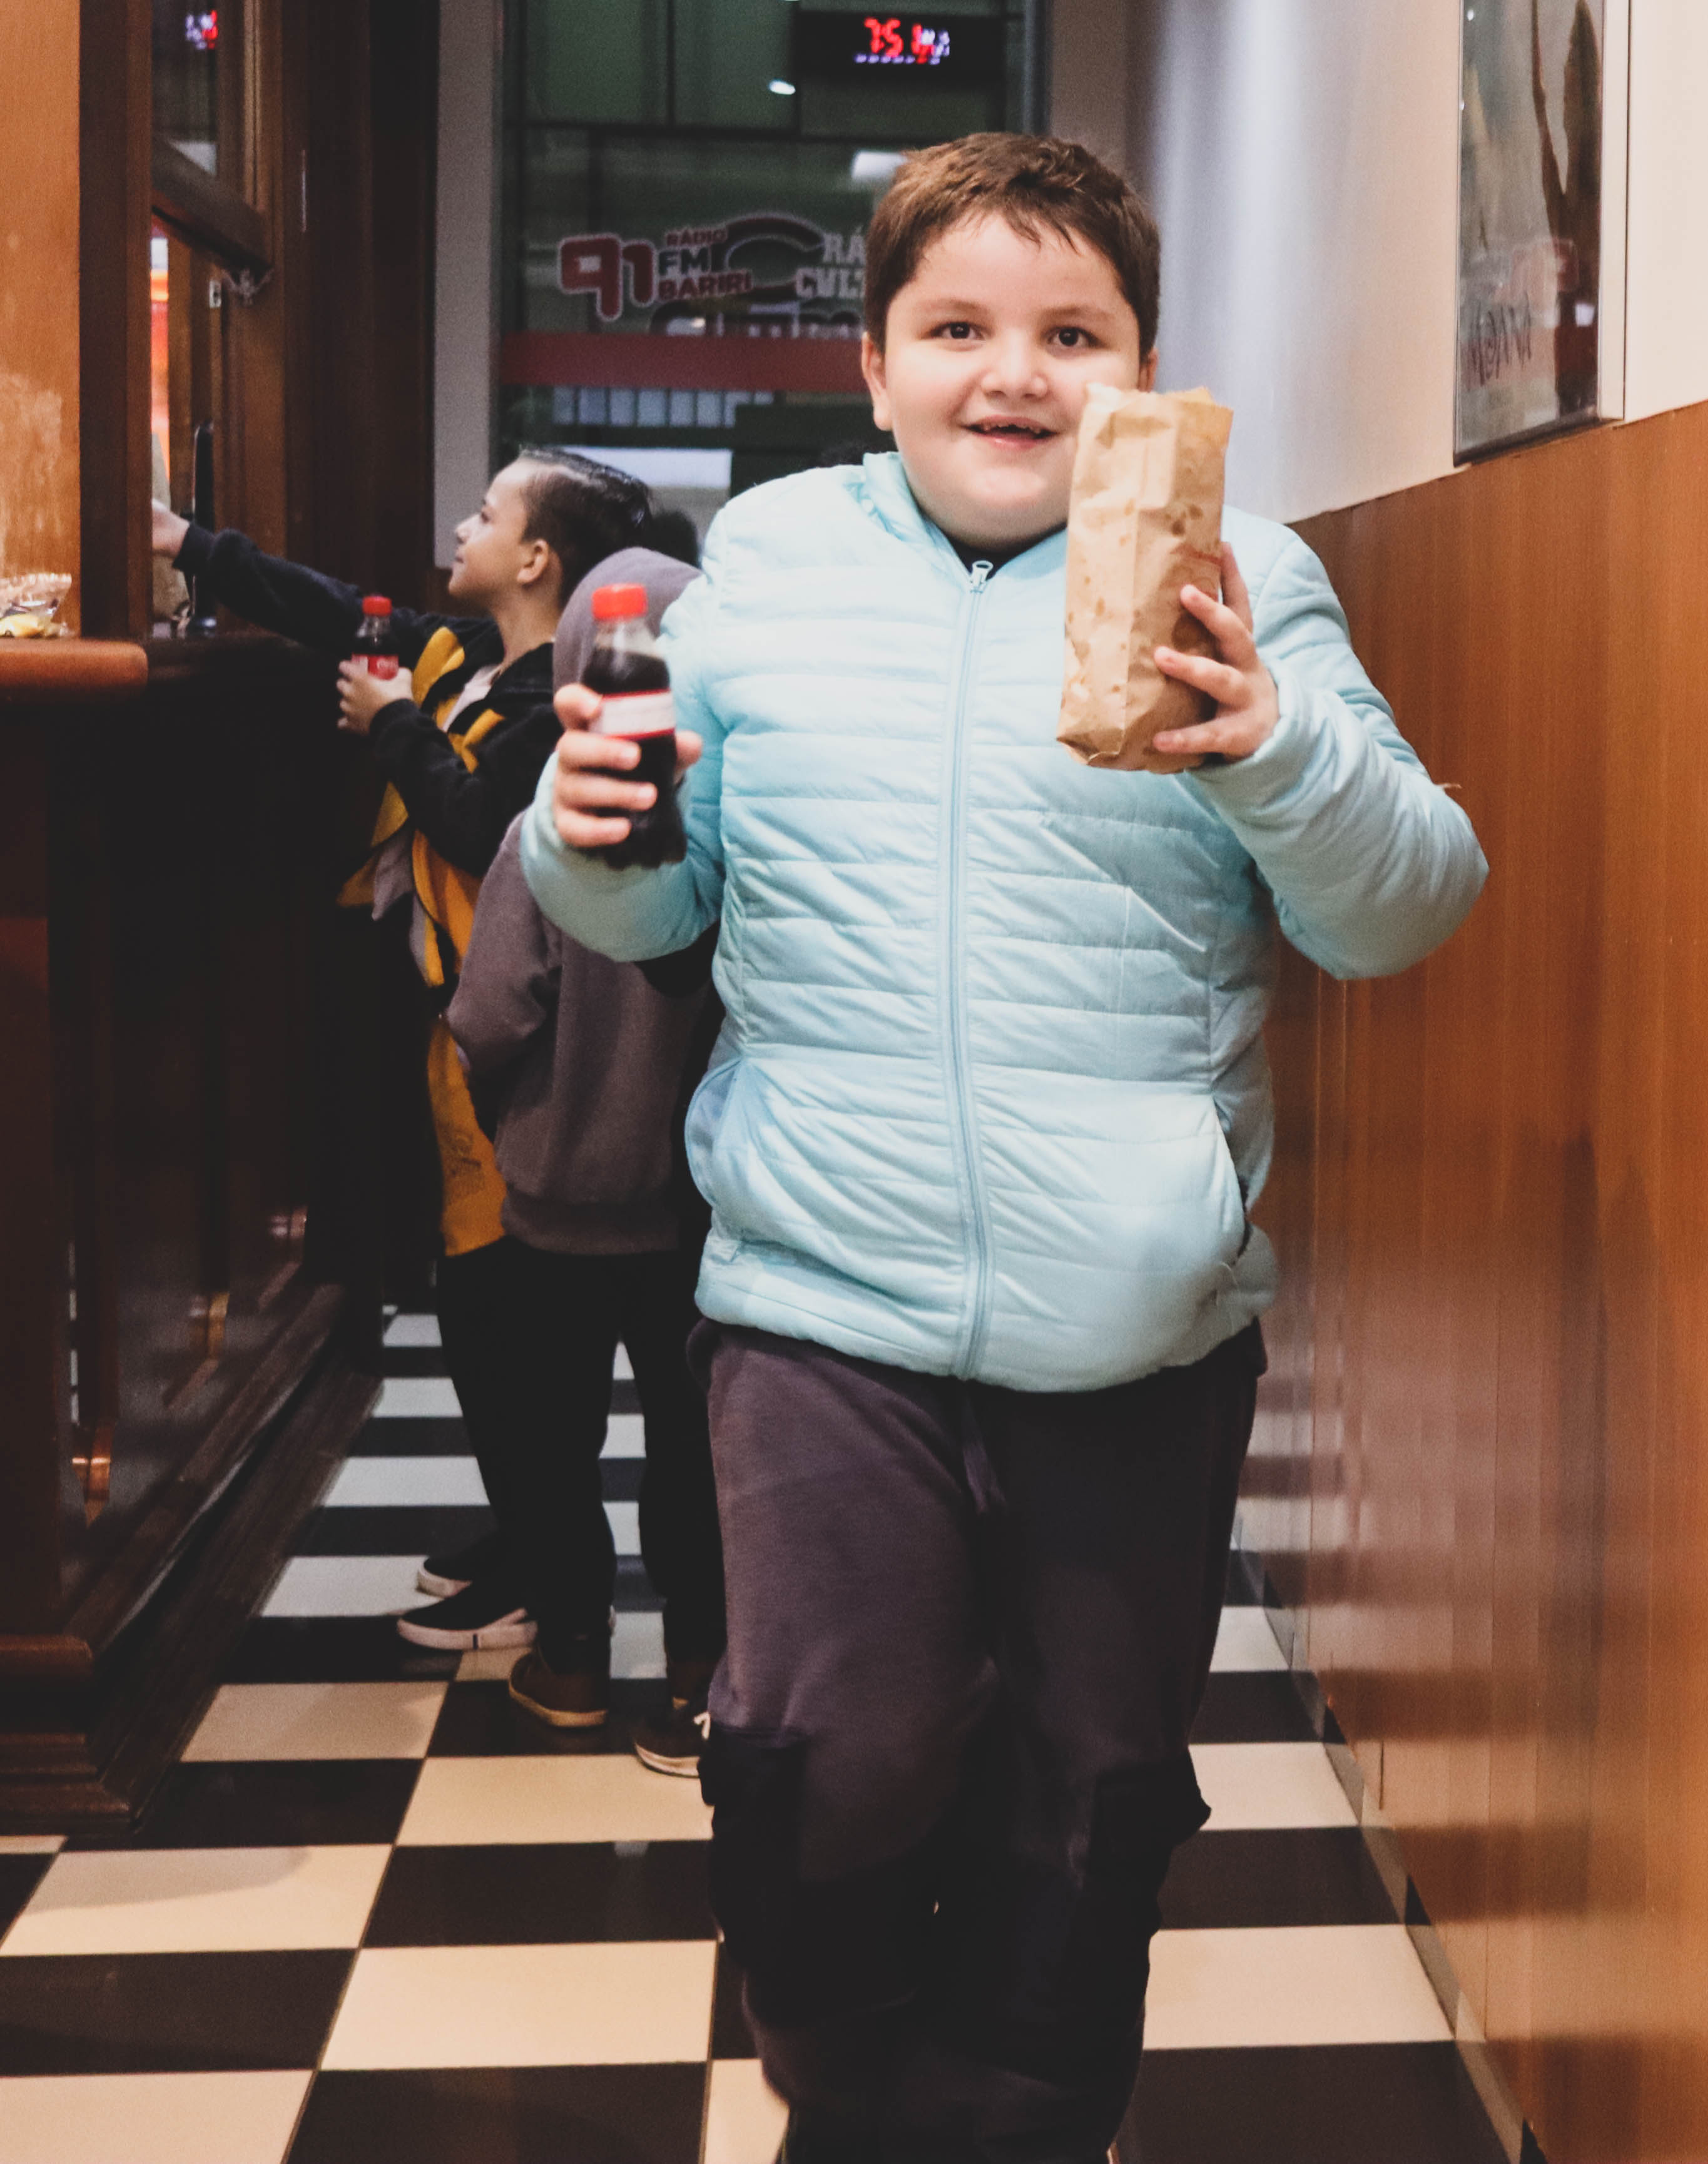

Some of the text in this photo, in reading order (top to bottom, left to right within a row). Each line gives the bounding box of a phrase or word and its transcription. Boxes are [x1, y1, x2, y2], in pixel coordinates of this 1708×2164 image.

[666, 221, 727, 246] RÁDIO
[658, 247, 709, 276] FM
[557, 233, 656, 322] 91
[657, 269, 753, 302] BARIRI
